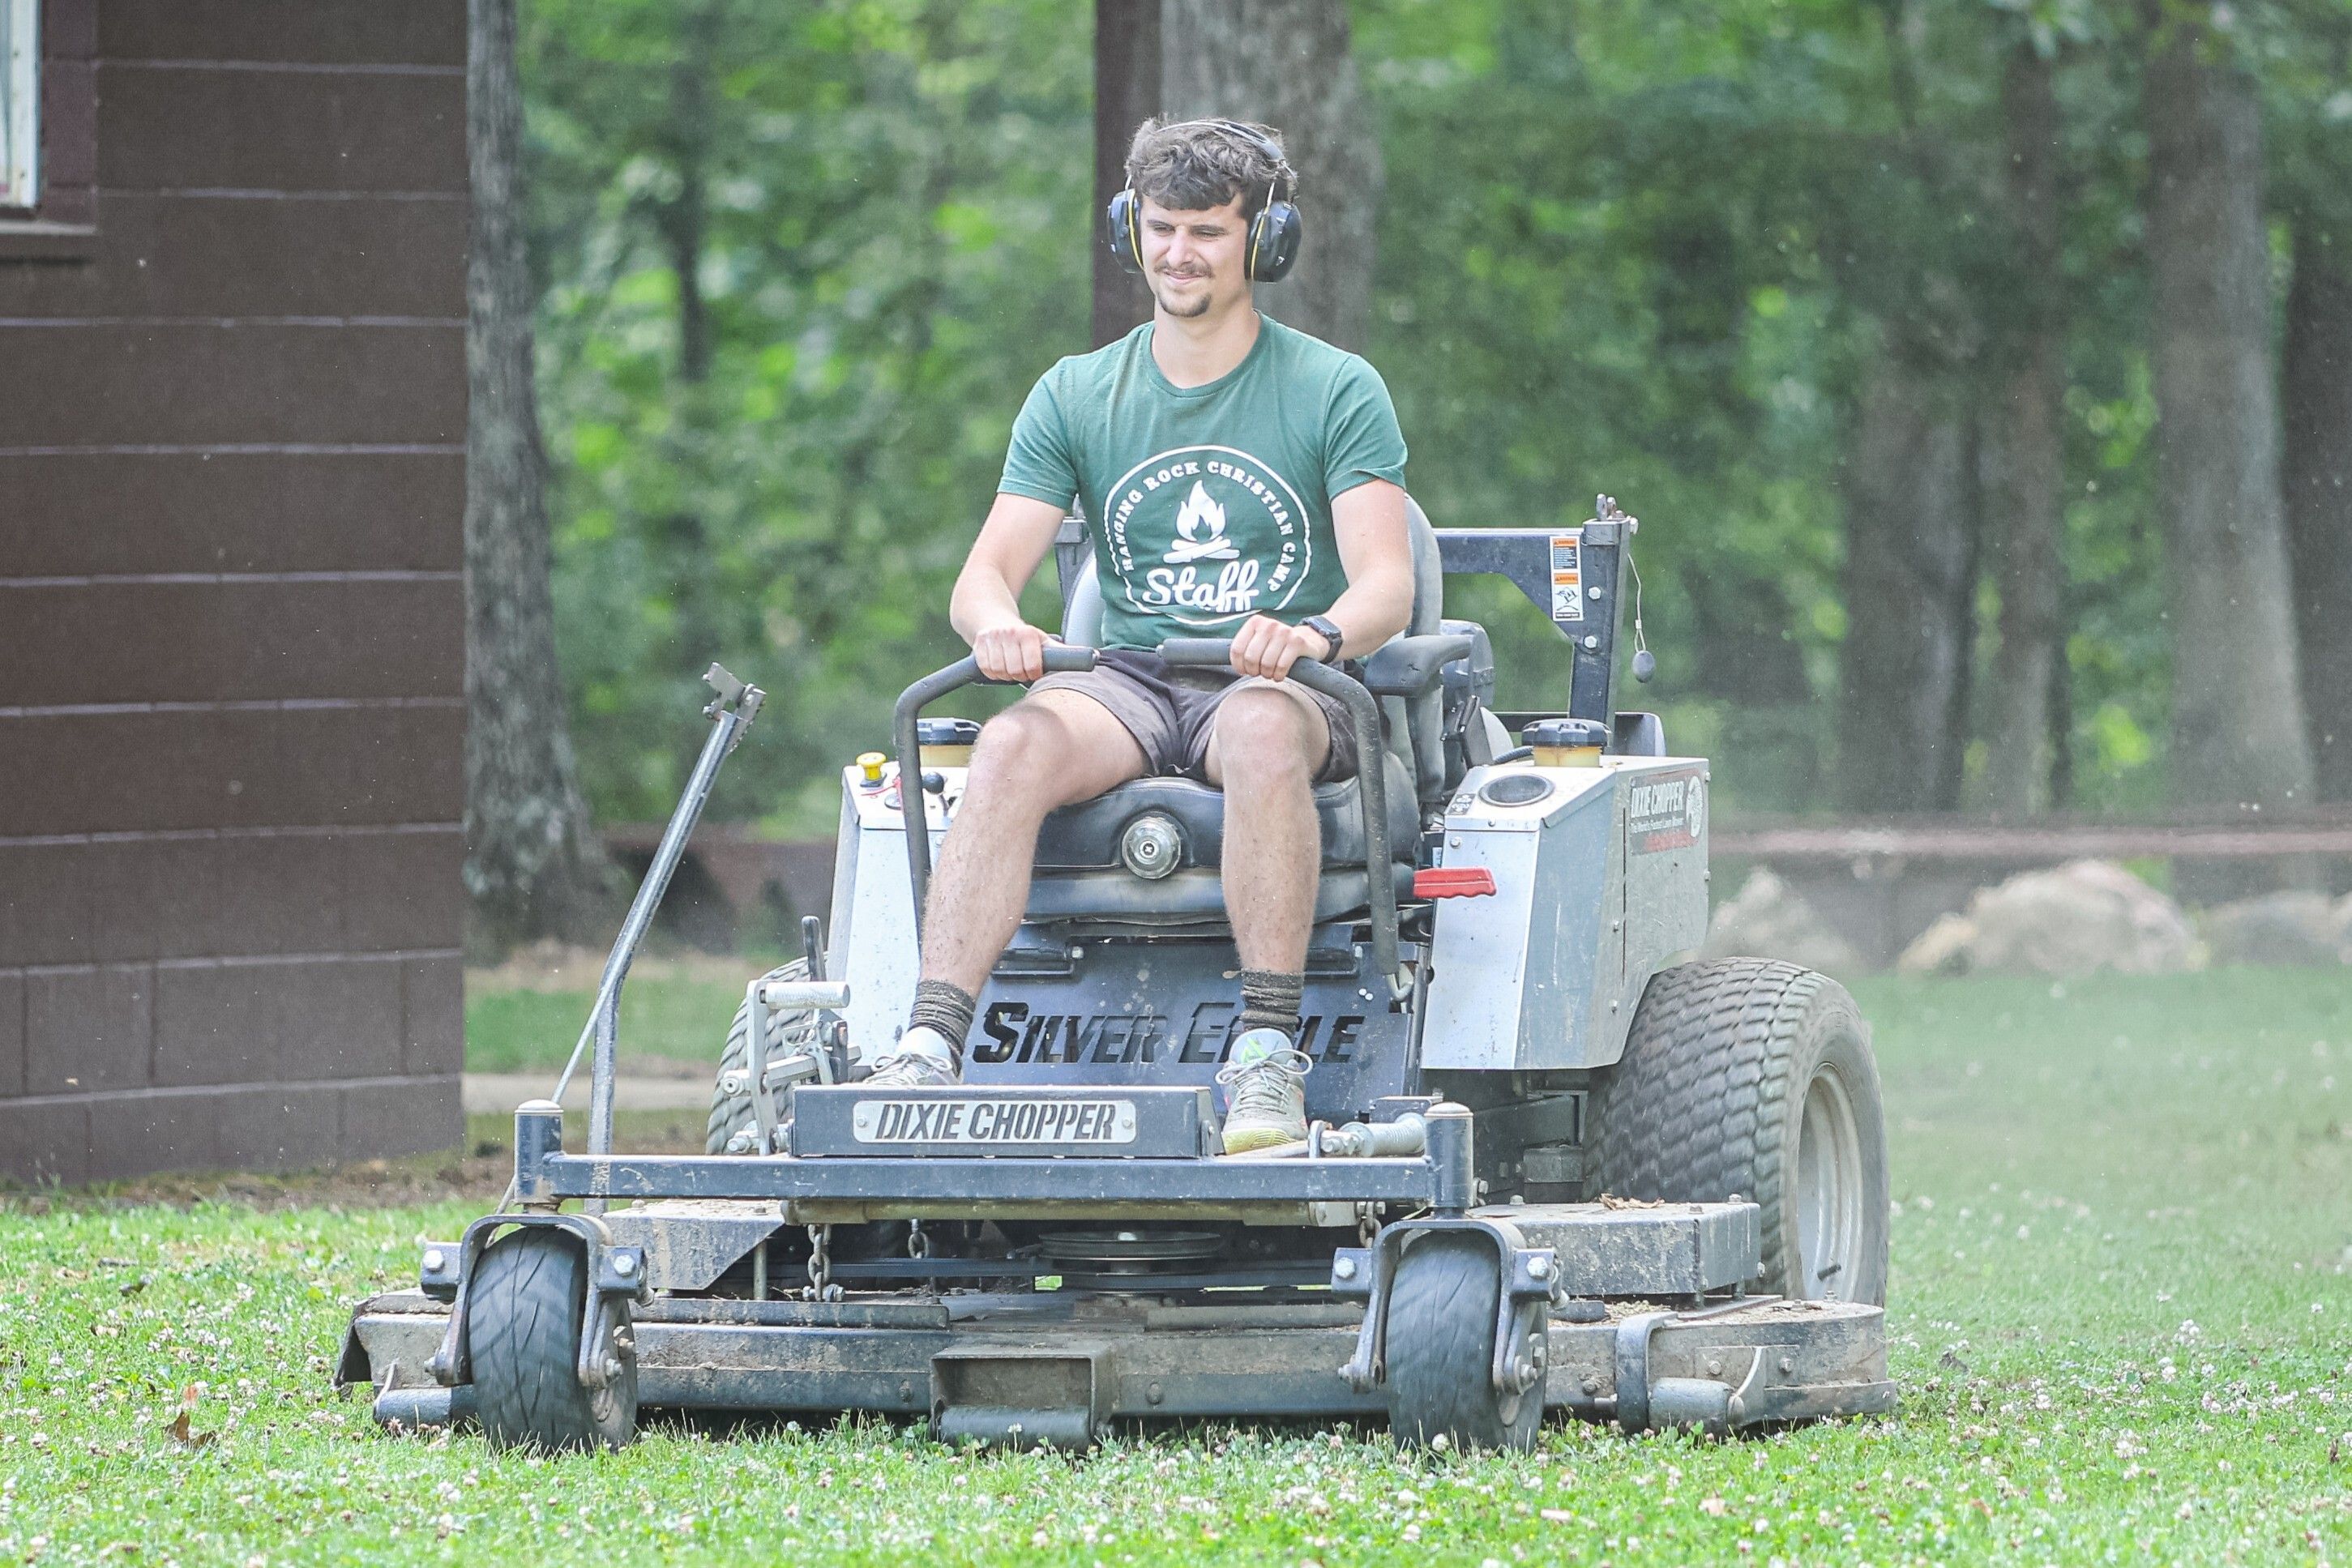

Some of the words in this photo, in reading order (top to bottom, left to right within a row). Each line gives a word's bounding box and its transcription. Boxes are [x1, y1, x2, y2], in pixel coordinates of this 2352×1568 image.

[1114, 489, 1144, 571] HANGING
[1143, 462, 1201, 491] ROCK
[1207, 461, 1294, 536] CHRISTIAN
[1267, 542, 1296, 592] CAMP
[1142, 559, 1259, 613] Staff
[973, 1002, 1168, 1063] SILVER
[875, 1103, 965, 1140] DIXIE
[968, 1103, 1116, 1140] CHOPPER
